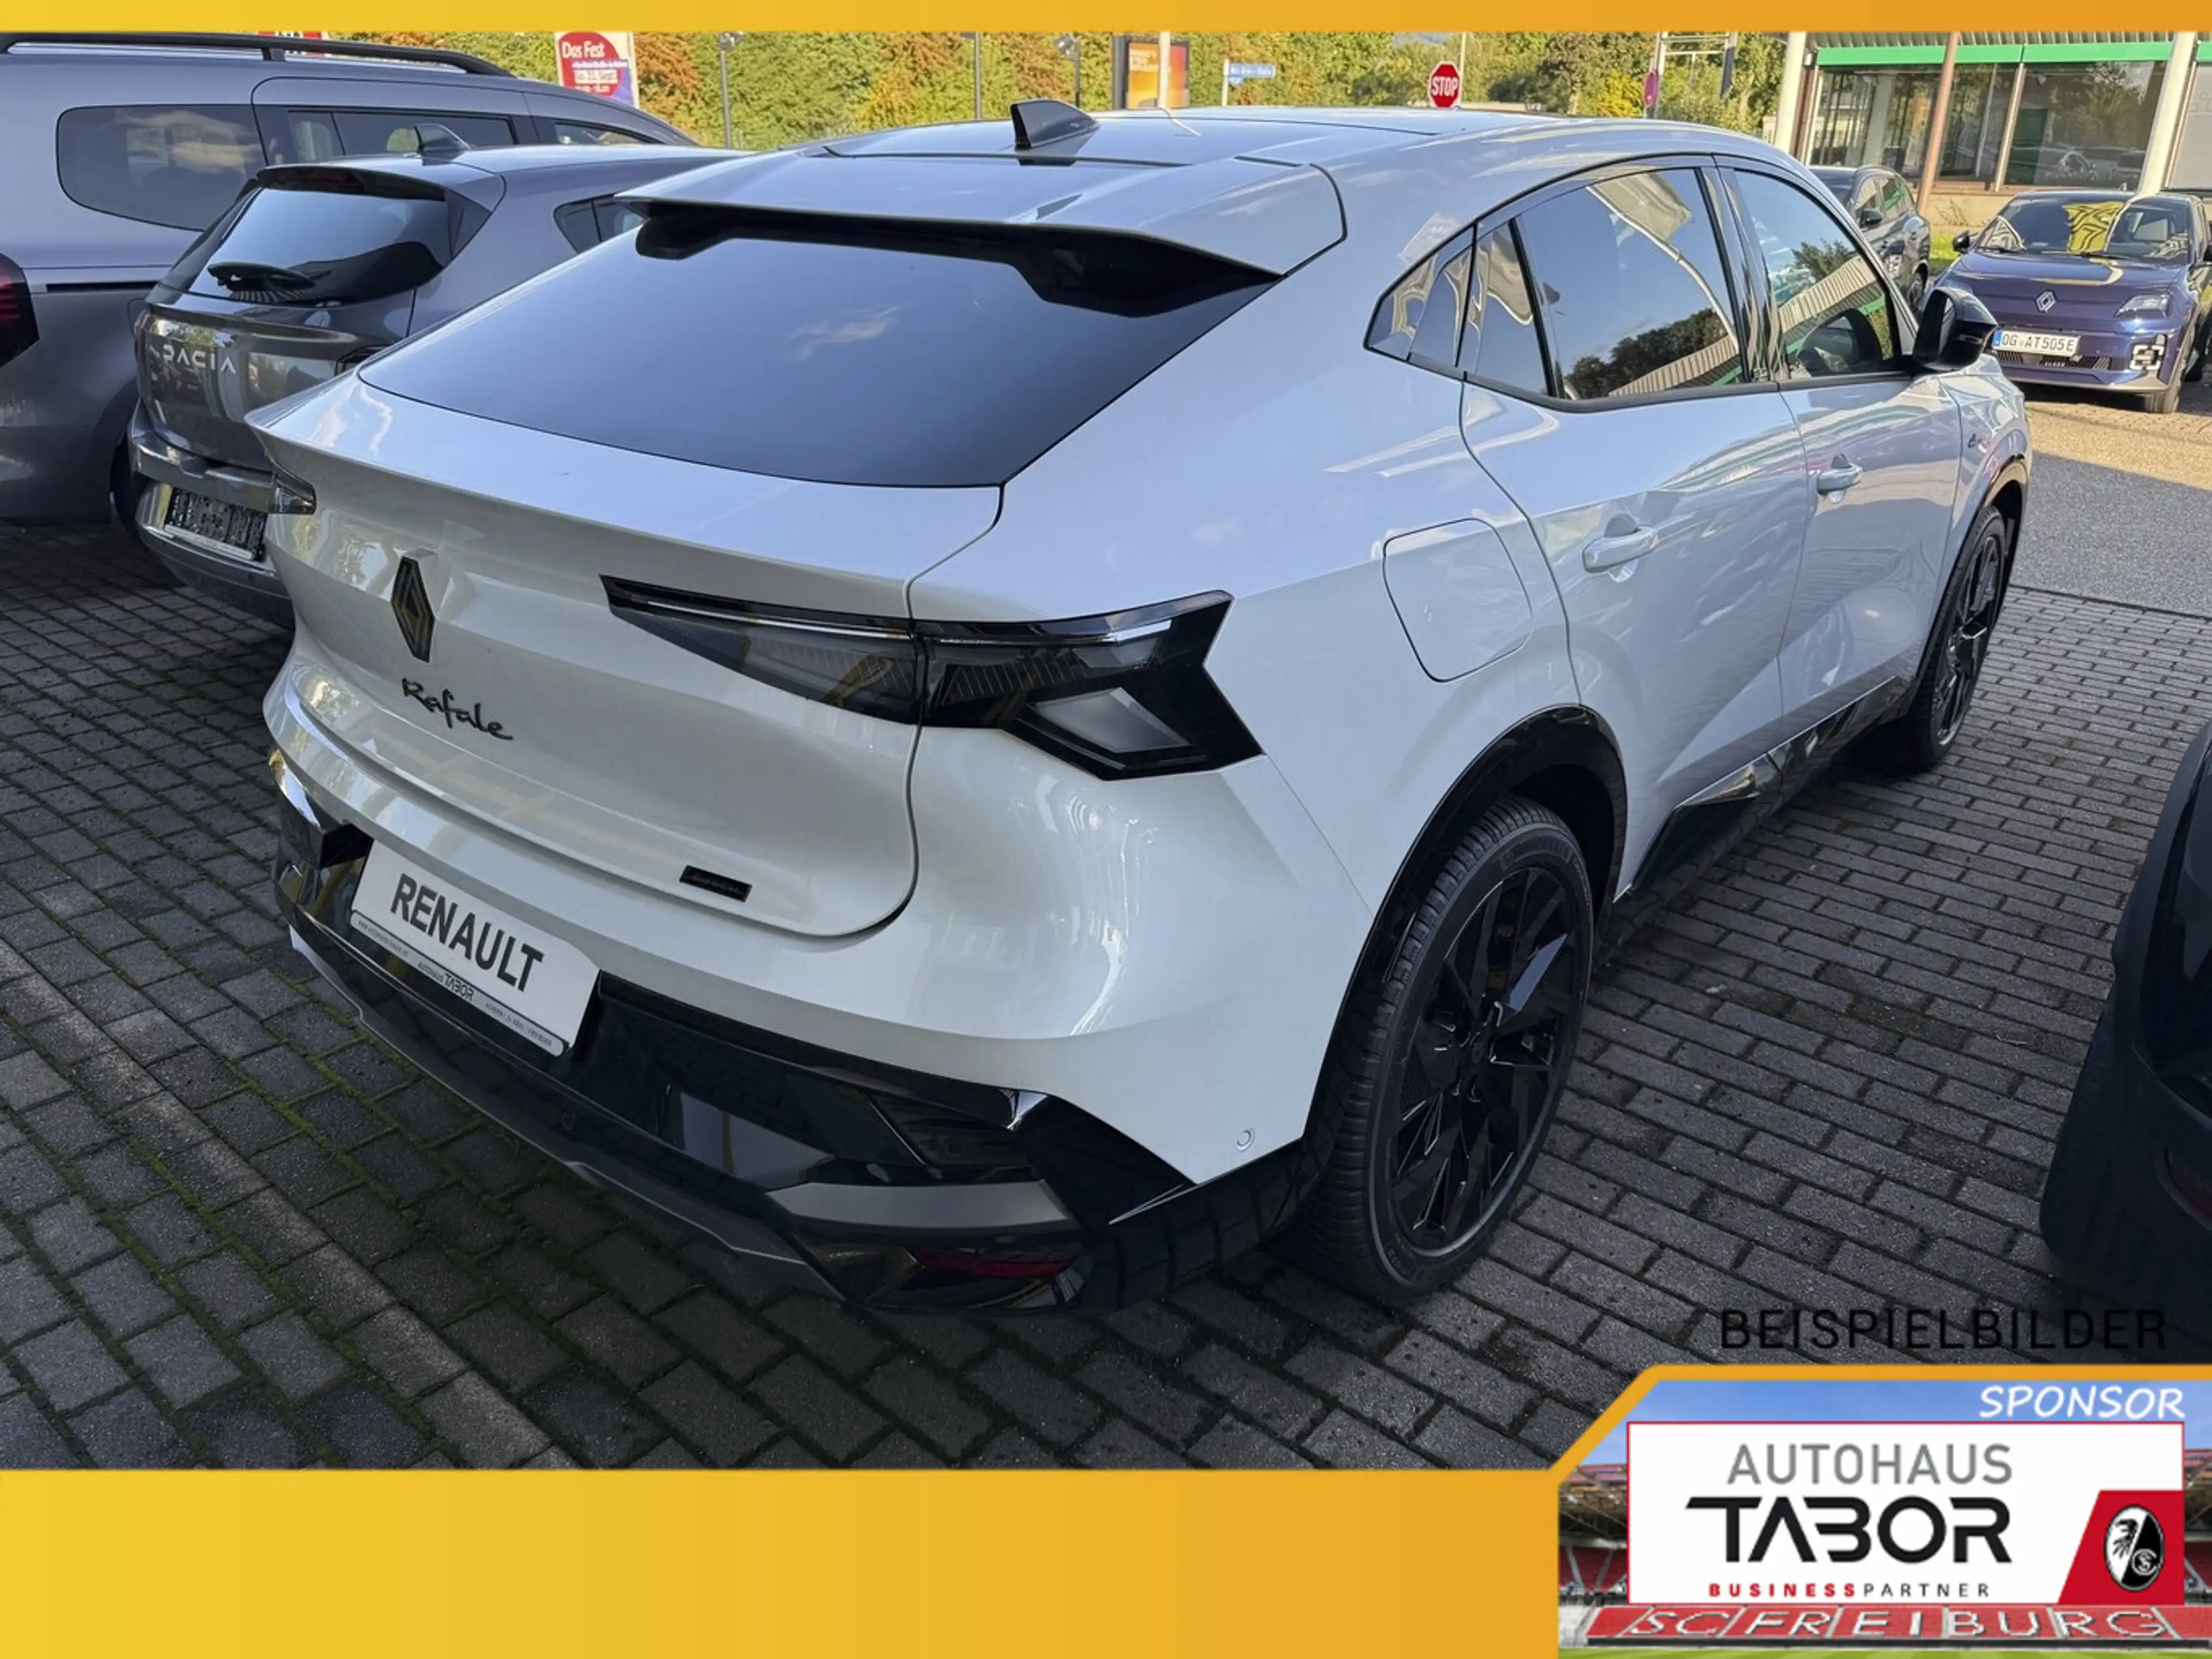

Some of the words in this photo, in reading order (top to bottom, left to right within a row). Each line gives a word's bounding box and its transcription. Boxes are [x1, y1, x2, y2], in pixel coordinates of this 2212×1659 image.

[562, 41, 583, 58] Das
[584, 40, 606, 58] Fest
[1432, 75, 1458, 97] STOP
[2002, 334, 2018, 346] OG
[162, 344, 237, 374] DACIA
[402, 677, 514, 741] Rafale
[390, 873, 545, 993] RENAULT
[444, 972, 474, 1002] TABOR
